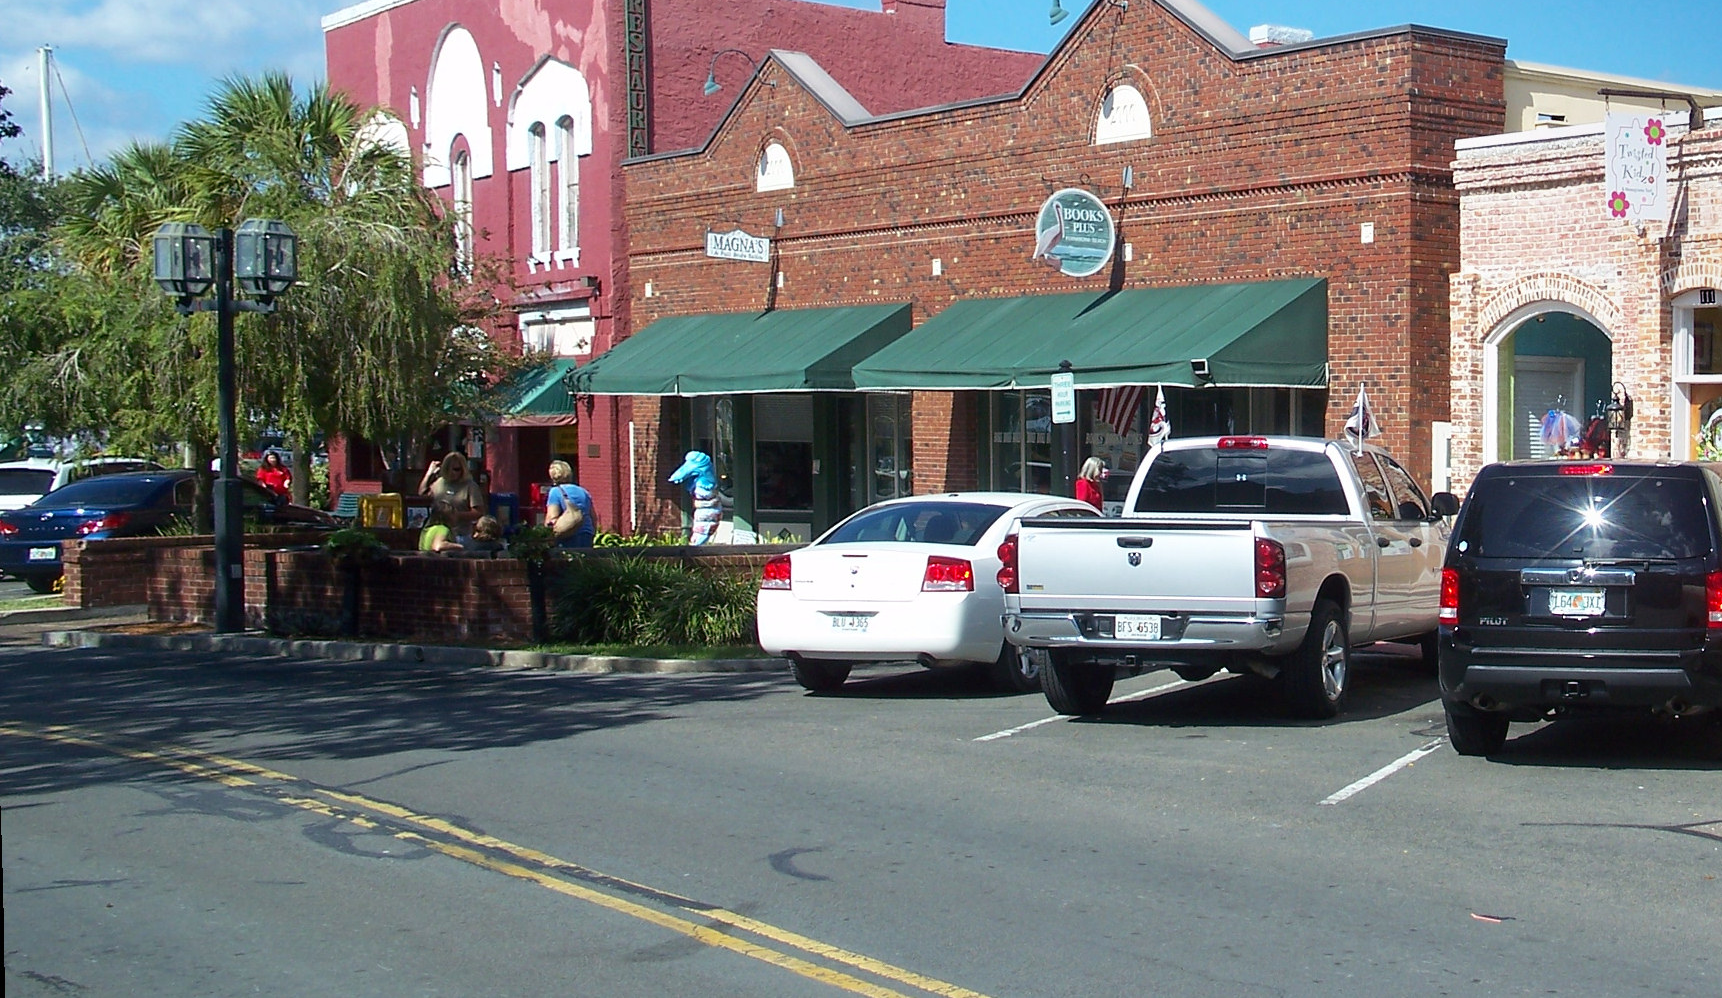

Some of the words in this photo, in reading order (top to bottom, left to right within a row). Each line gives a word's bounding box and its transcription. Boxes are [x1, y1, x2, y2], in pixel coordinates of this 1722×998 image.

[1619, 144, 1655, 161] Twisted
[1063, 207, 1104, 222] BOOKS
[1073, 221, 1096, 234] PLUS
[713, 234, 764, 254] MAGNA'S
[1701, 290, 1714, 303] 111
[1117, 621, 1133, 633] BFS
[1137, 621, 1159, 634] 6538
[1479, 617, 1508, 625] PILOT
